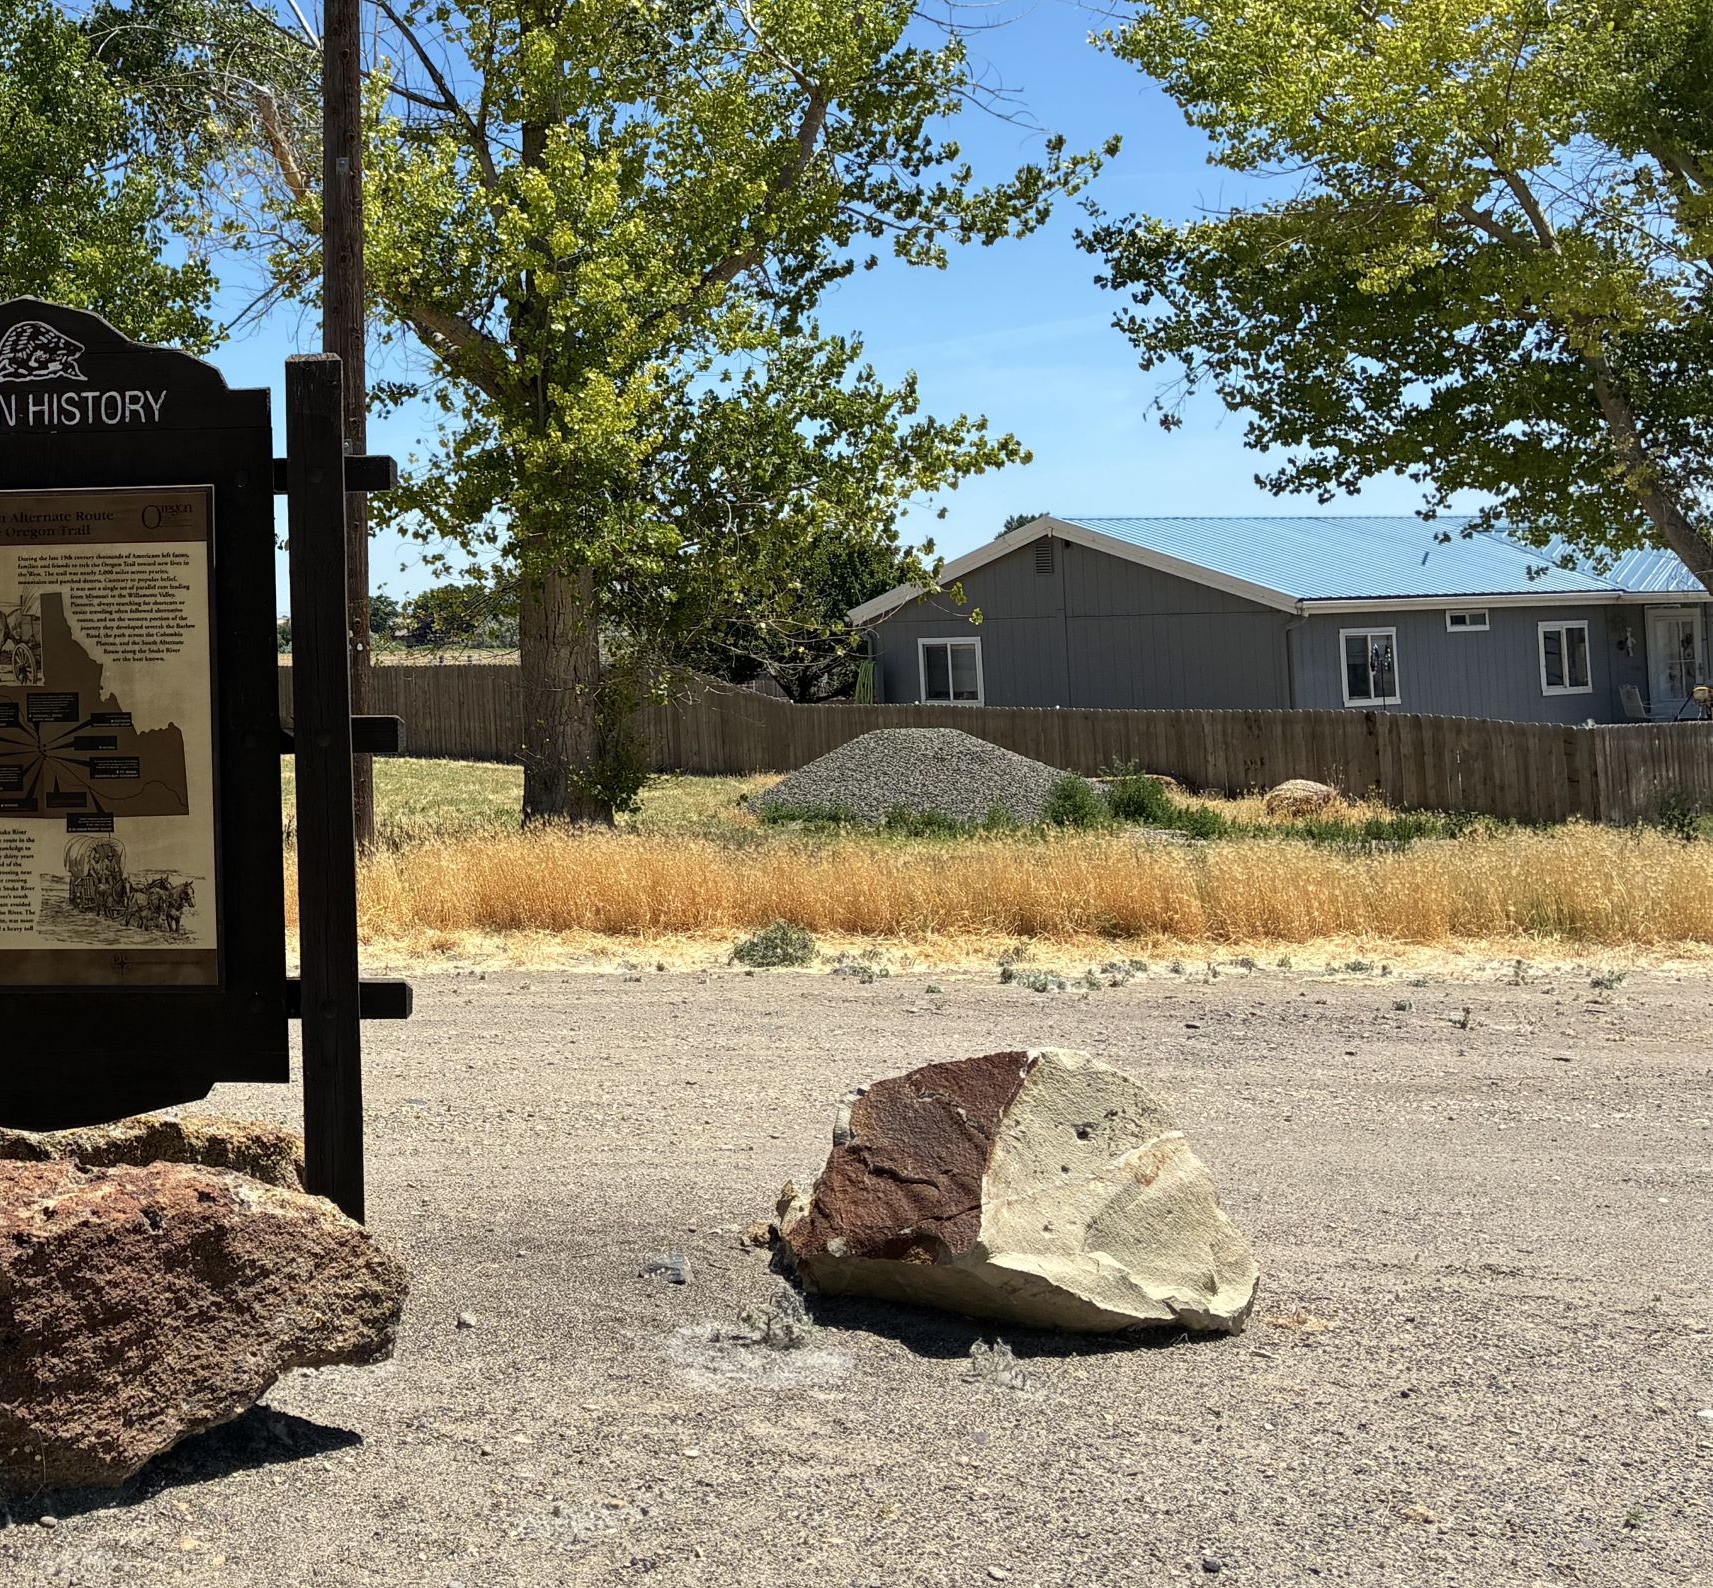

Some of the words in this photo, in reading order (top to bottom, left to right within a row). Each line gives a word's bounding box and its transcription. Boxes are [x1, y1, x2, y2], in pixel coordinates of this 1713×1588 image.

[28, 390, 167, 426] HISTORY
[9, 512, 72, 524] Alternate
[76, 511, 114, 521] Route
[142, 504, 192, 529] Oregon
[6, 526, 55, 540] Oregon
[58, 524, 90, 536] Trail
[3, 852, 18, 861] thirty
[6, 925, 22, 933] heavy
